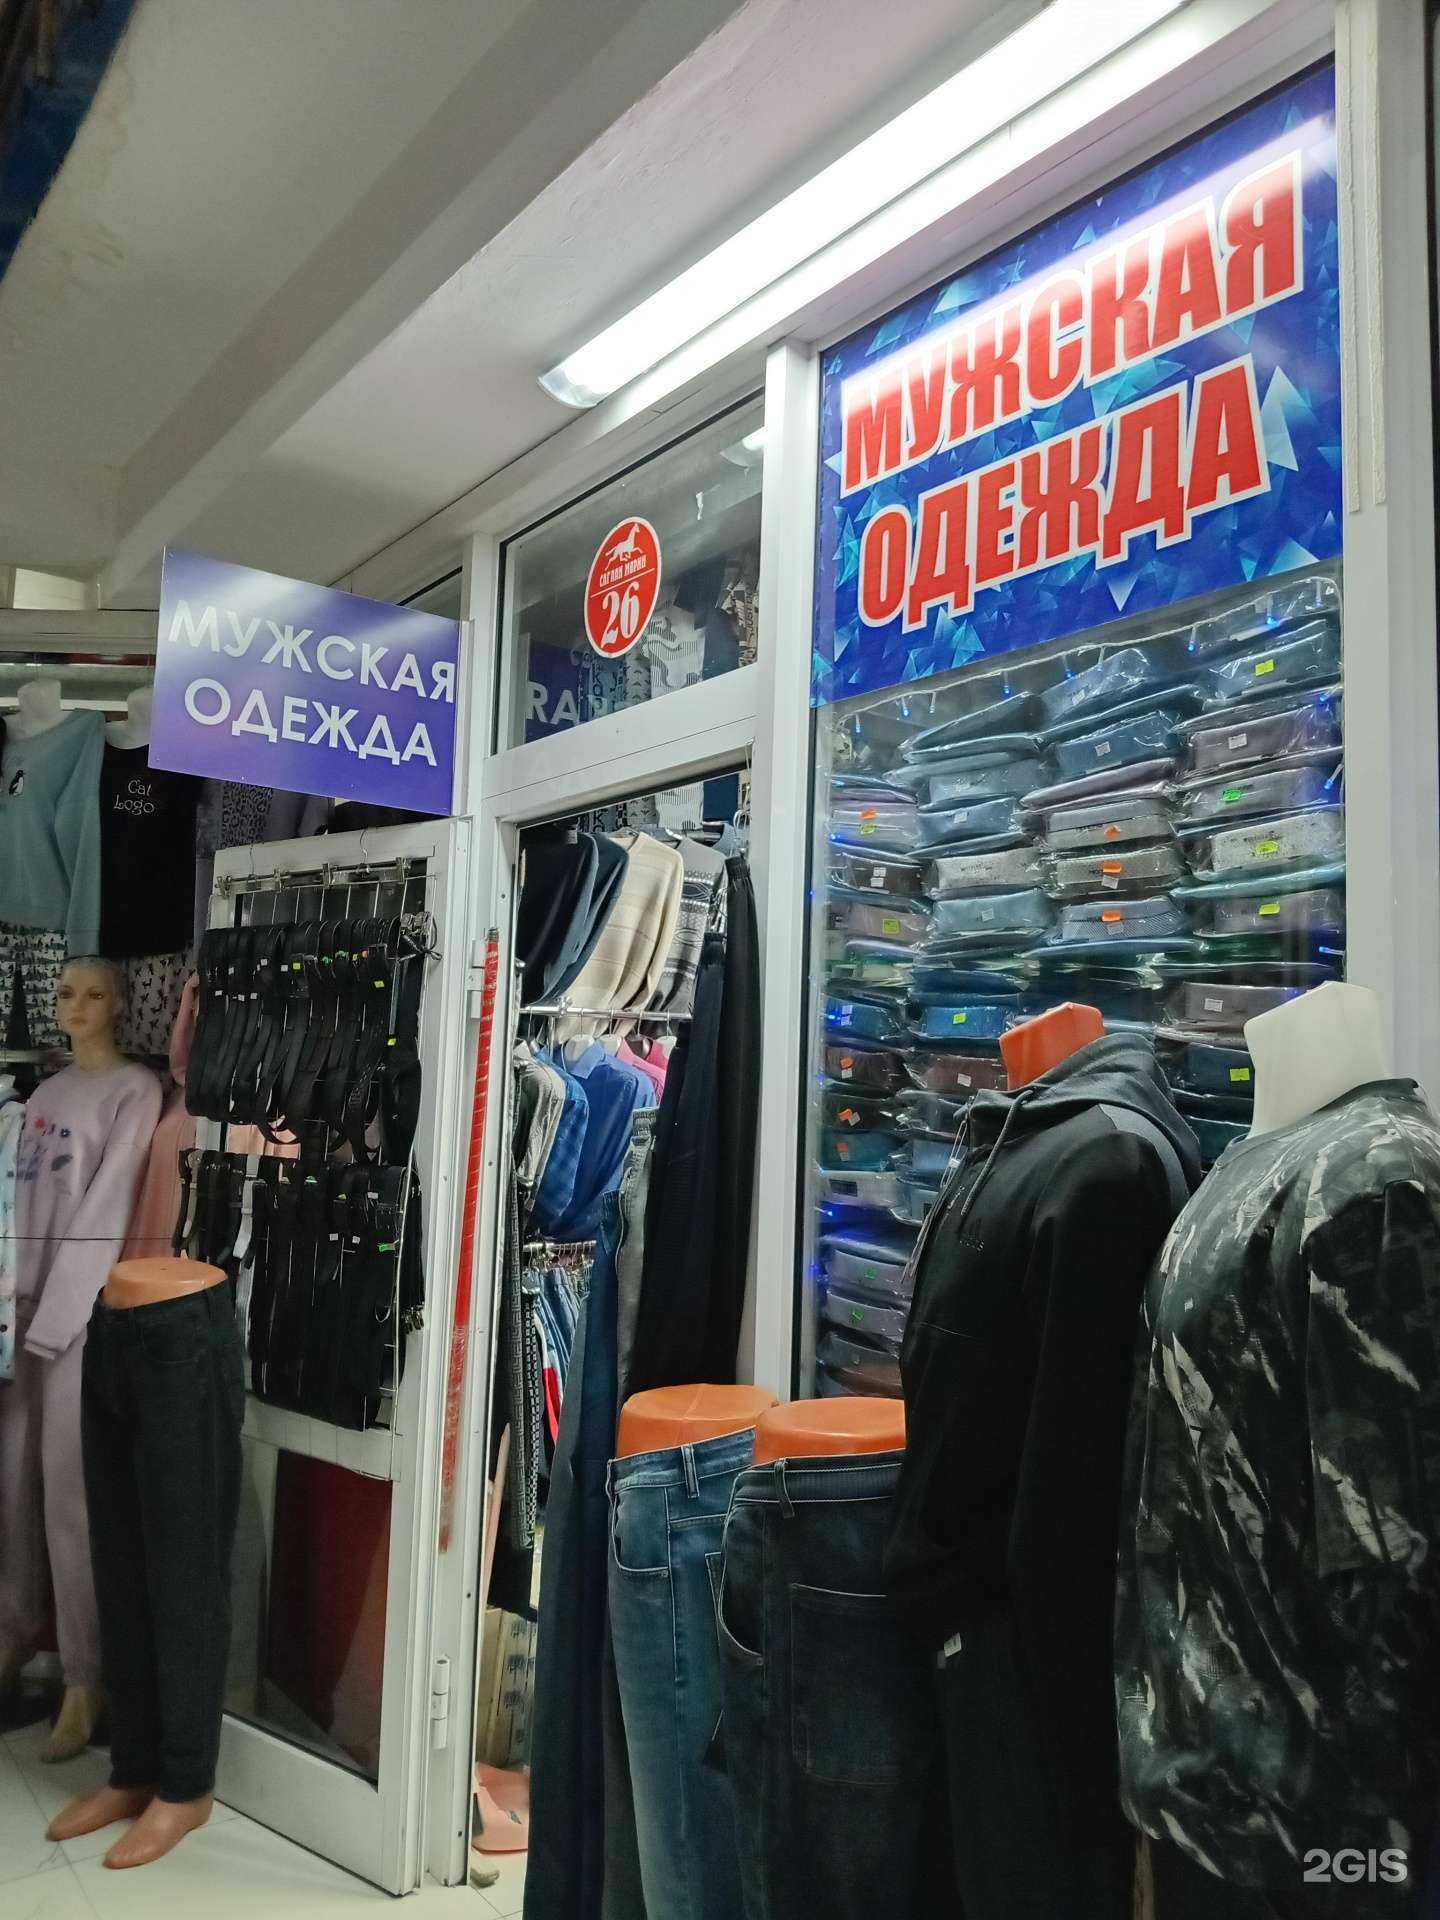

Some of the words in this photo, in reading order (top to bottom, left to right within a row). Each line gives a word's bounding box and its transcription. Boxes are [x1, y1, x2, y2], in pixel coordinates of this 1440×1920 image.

[841, 149, 1304, 499] МУЖСКАЯ
[858, 353, 1272, 634] ОДЕЖДА
[168, 600, 456, 703] МУЖСКАЯ
[601, 581, 640, 649] 26
[184, 678, 437, 767] ОДЕЖДА
[113, 794, 155, 816] Logo
